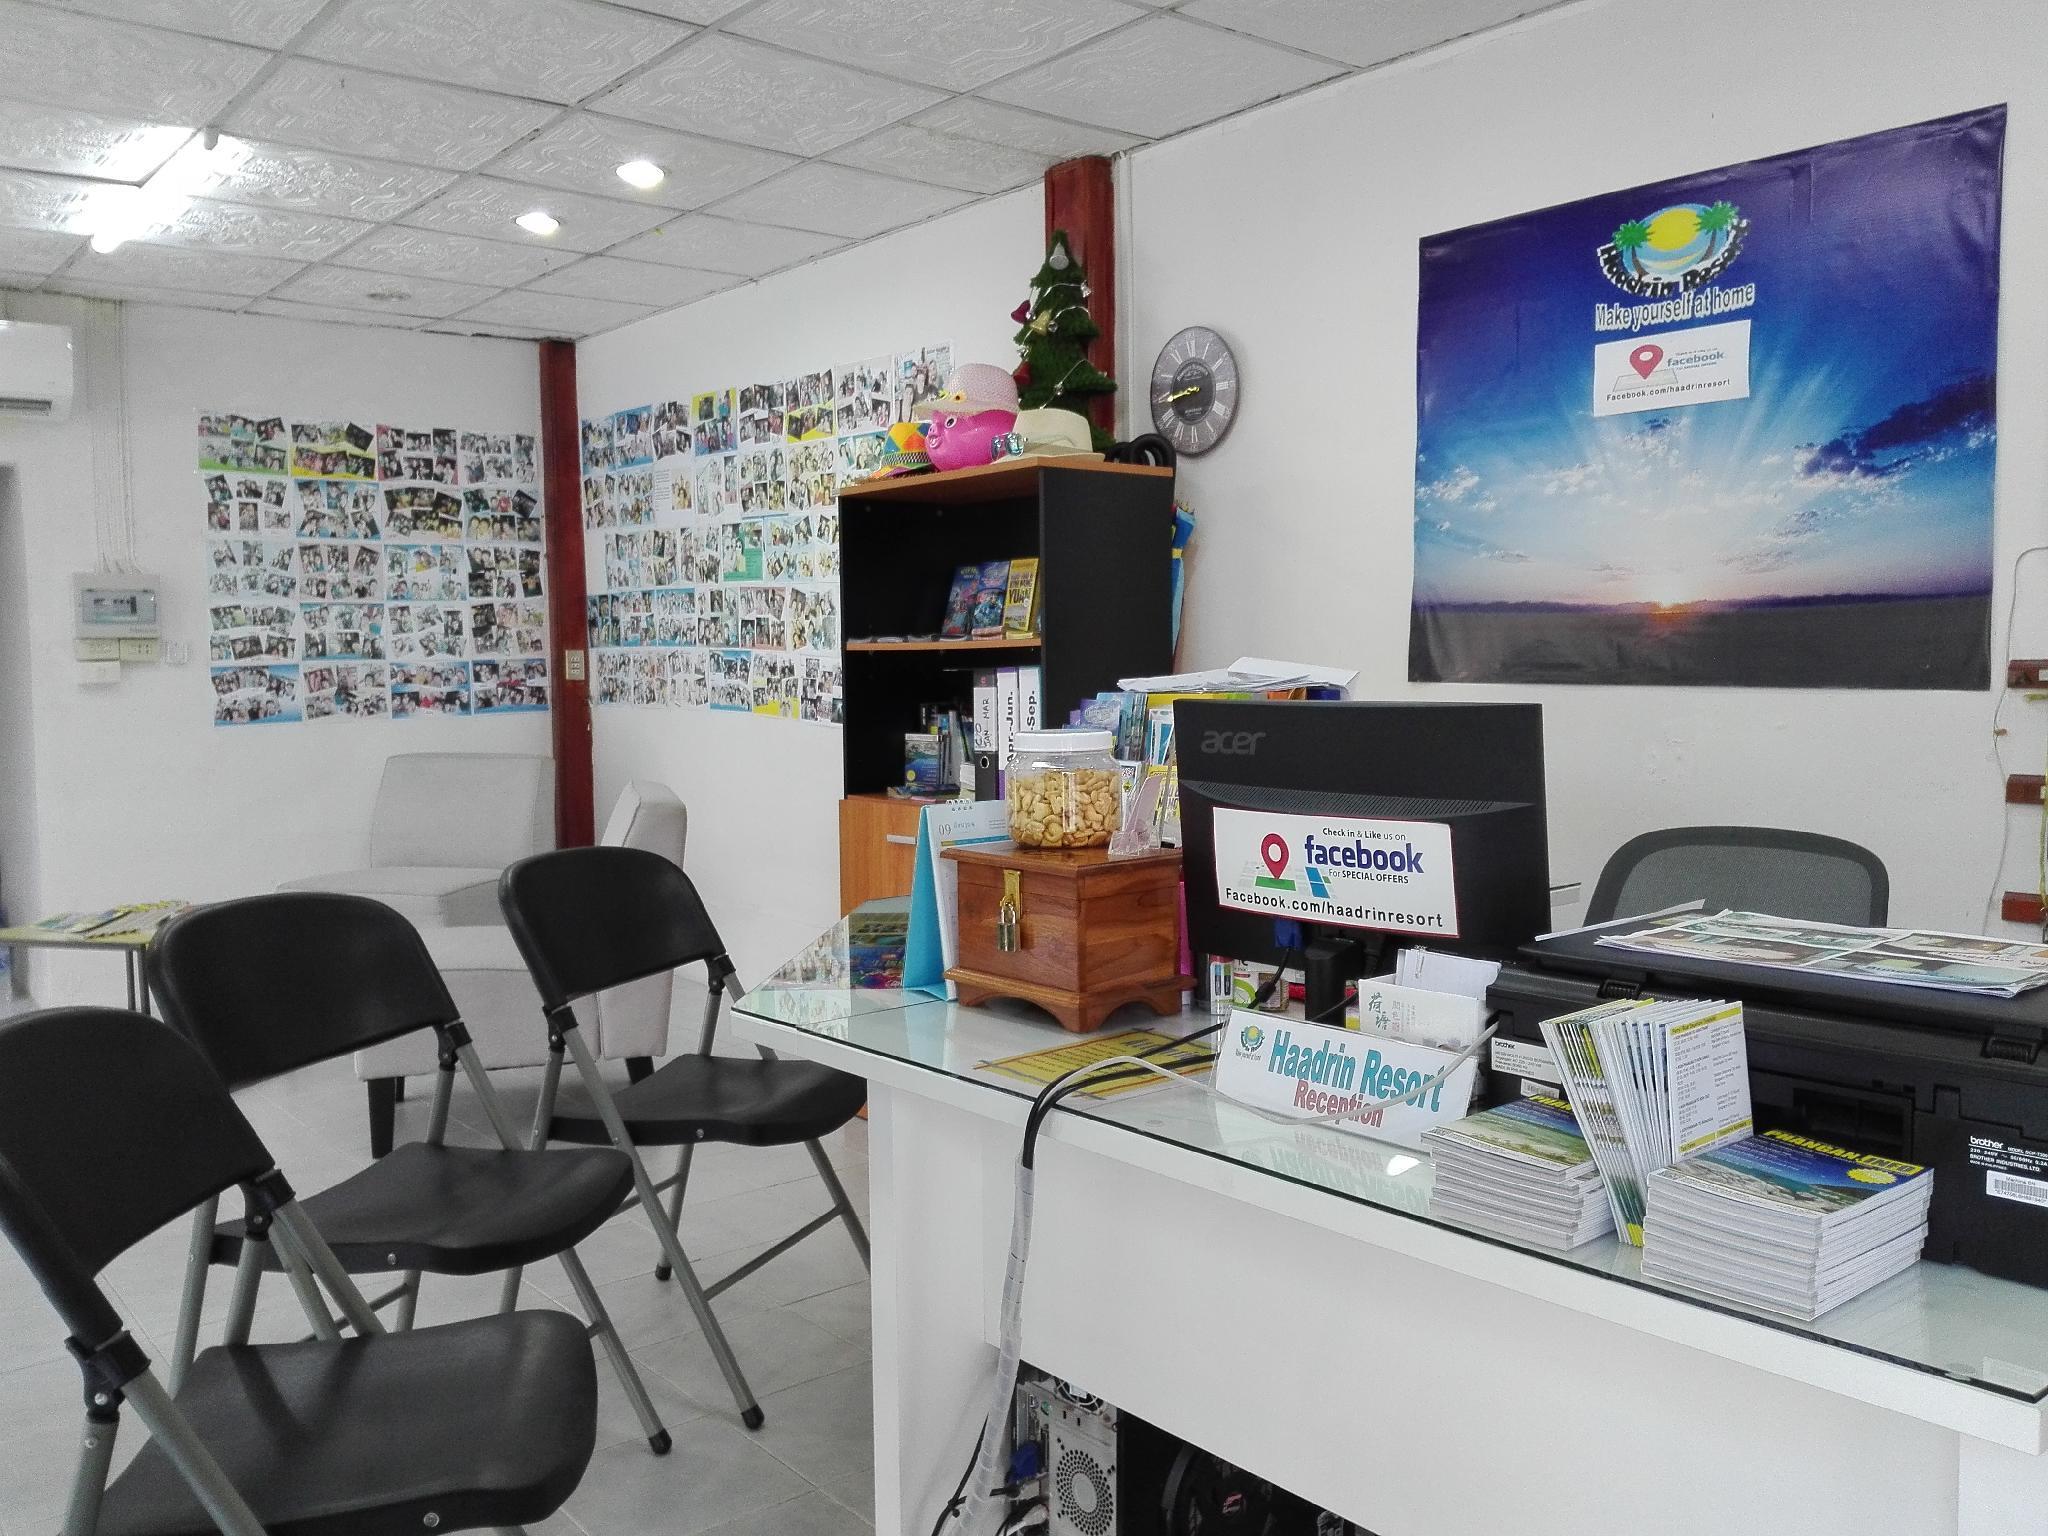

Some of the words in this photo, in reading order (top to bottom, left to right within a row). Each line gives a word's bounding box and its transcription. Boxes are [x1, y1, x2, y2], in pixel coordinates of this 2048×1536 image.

[1597, 243, 1674, 298] Haadrin
[1596, 302, 1632, 331] Make
[1632, 291, 1693, 332] yourself
[1695, 288, 1710, 318] at
[1711, 283, 1755, 314] home
[1667, 351, 1725, 367] facebook
[1606, 379, 1730, 401] Facebook.com/haadrinresort
[1200, 730, 1266, 755] acer
[938, 823, 952, 835] 09
[1322, 827, 1346, 837] Check
[1347, 829, 1355, 838] in
[1364, 830, 1382, 840] Like
[1304, 835, 1424, 873] facebook
[1329, 868, 1340, 877] For
[1342, 870, 1374, 881] SPECIAL
[1376, 873, 1409, 884] OFFERS
[1226, 888, 1443, 927] Facebook.com/haadrinresort
[1268, 1029, 1356, 1090] Haadrin
[1360, 1049, 1446, 1112] Resort
[1294, 1080, 1384, 1128] Reception
[1970, 1136, 2003, 1149] brother
[1969, 1153, 1995, 1162] BROTHER
